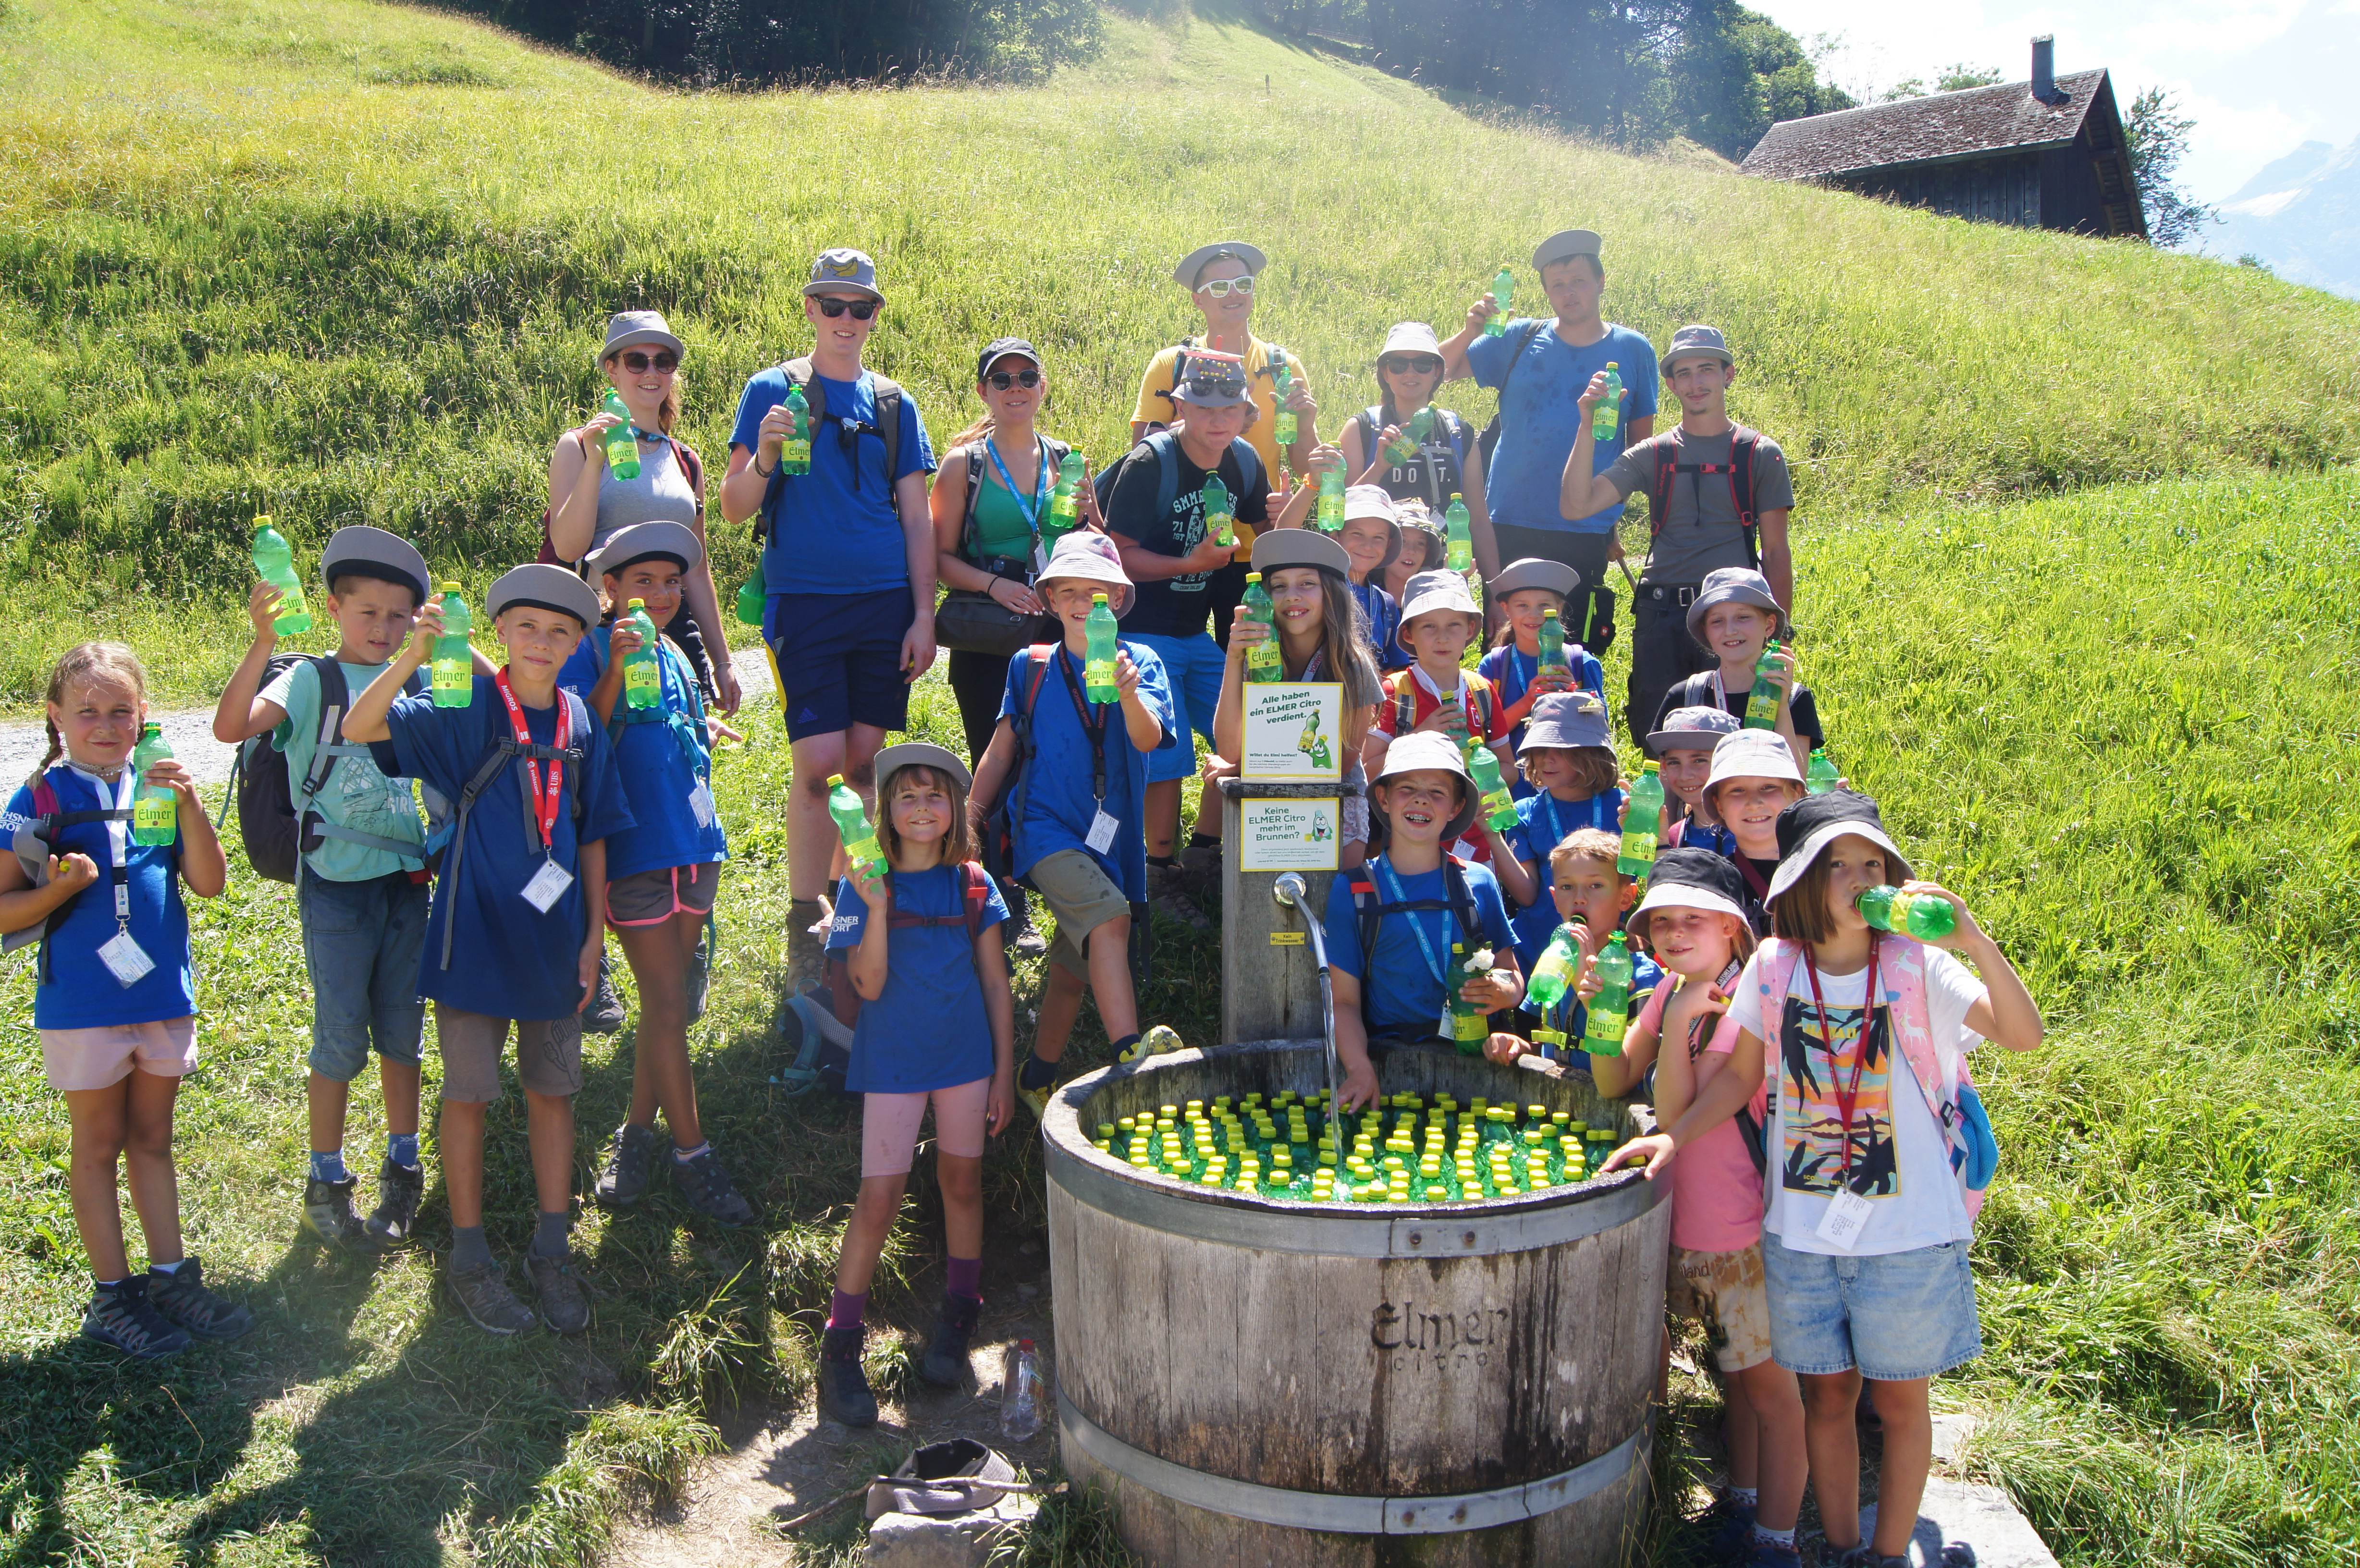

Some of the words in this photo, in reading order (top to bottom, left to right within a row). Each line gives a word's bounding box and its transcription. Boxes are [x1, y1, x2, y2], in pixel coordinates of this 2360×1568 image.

[1595, 413, 1615, 421] Elmer
[609, 449, 632, 460] Elmer
[1172, 521, 1183, 532] 71
[1210, 520, 1230, 528] Elmer
[1252, 650, 1278, 662] Elmer
[434, 670, 466, 682] Elmer
[631, 671, 658, 682] Elmer
[1086, 670, 1112, 681] Elmer
[501, 685, 518, 711] MIGROS
[1262, 696, 1279, 705] Alle
[1282, 691, 1310, 701] haben
[1073, 688, 1085, 712] OCHSNER
[1082, 711, 1092, 727] SPORT
[1250, 708, 1264, 716] ein
[1266, 703, 1297, 714] ELMER
[1300, 699, 1321, 708] Citro
[1749, 702, 1774, 714] Elmer
[1266, 711, 1307, 724] verdient.
[530, 769, 540, 796] swisscom
[550, 771, 559, 785] UBS
[138, 808, 172, 821] Elmer
[1249, 816, 1281, 824] ELMER
[1256, 832, 1300, 841] Brunnen?
[1587, 1017, 1619, 1033] Elmer
[1370, 1301, 1510, 1351] Elmer
[1393, 1352, 1488, 1371] citro
